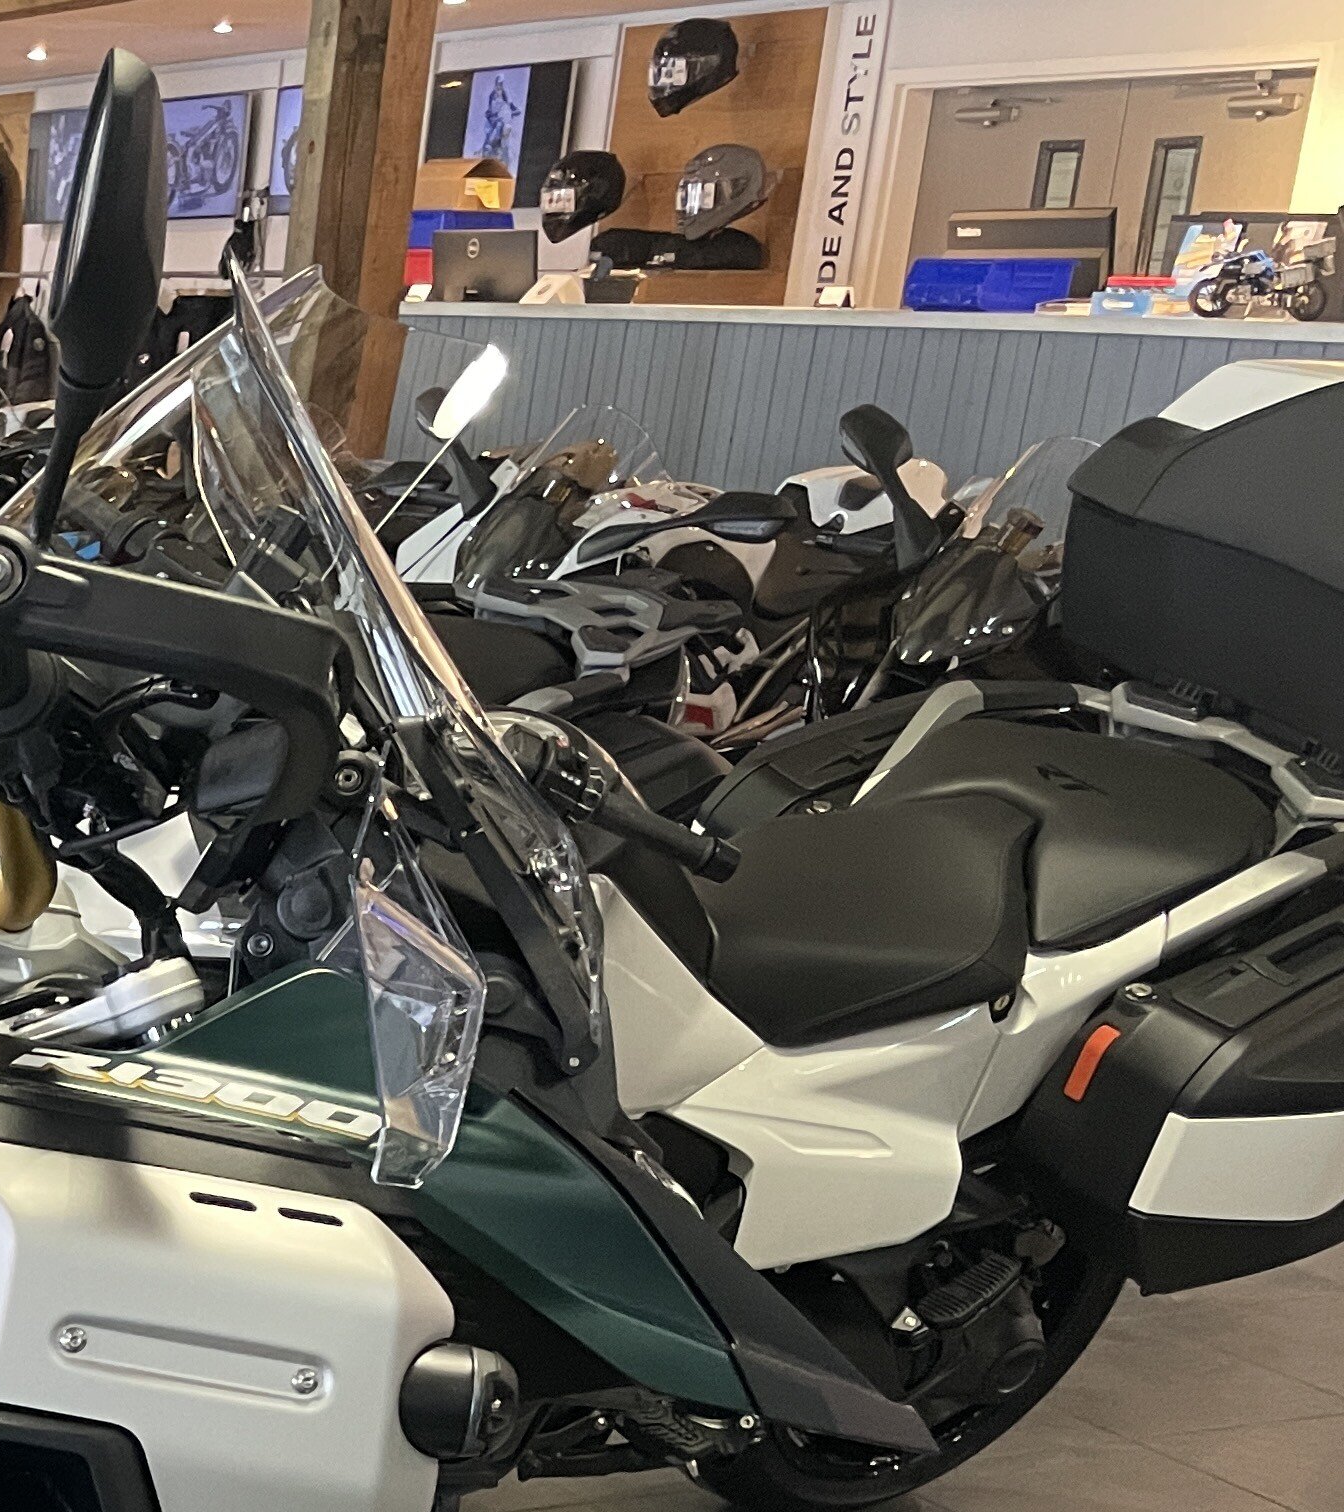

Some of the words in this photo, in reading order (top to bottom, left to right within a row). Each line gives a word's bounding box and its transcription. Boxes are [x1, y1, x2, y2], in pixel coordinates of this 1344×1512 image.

[841, 14, 877, 137] STYLE
[827, 147, 854, 226] AND
[814, 236, 842, 306] DE
[10, 1047, 383, 1141] R1300
